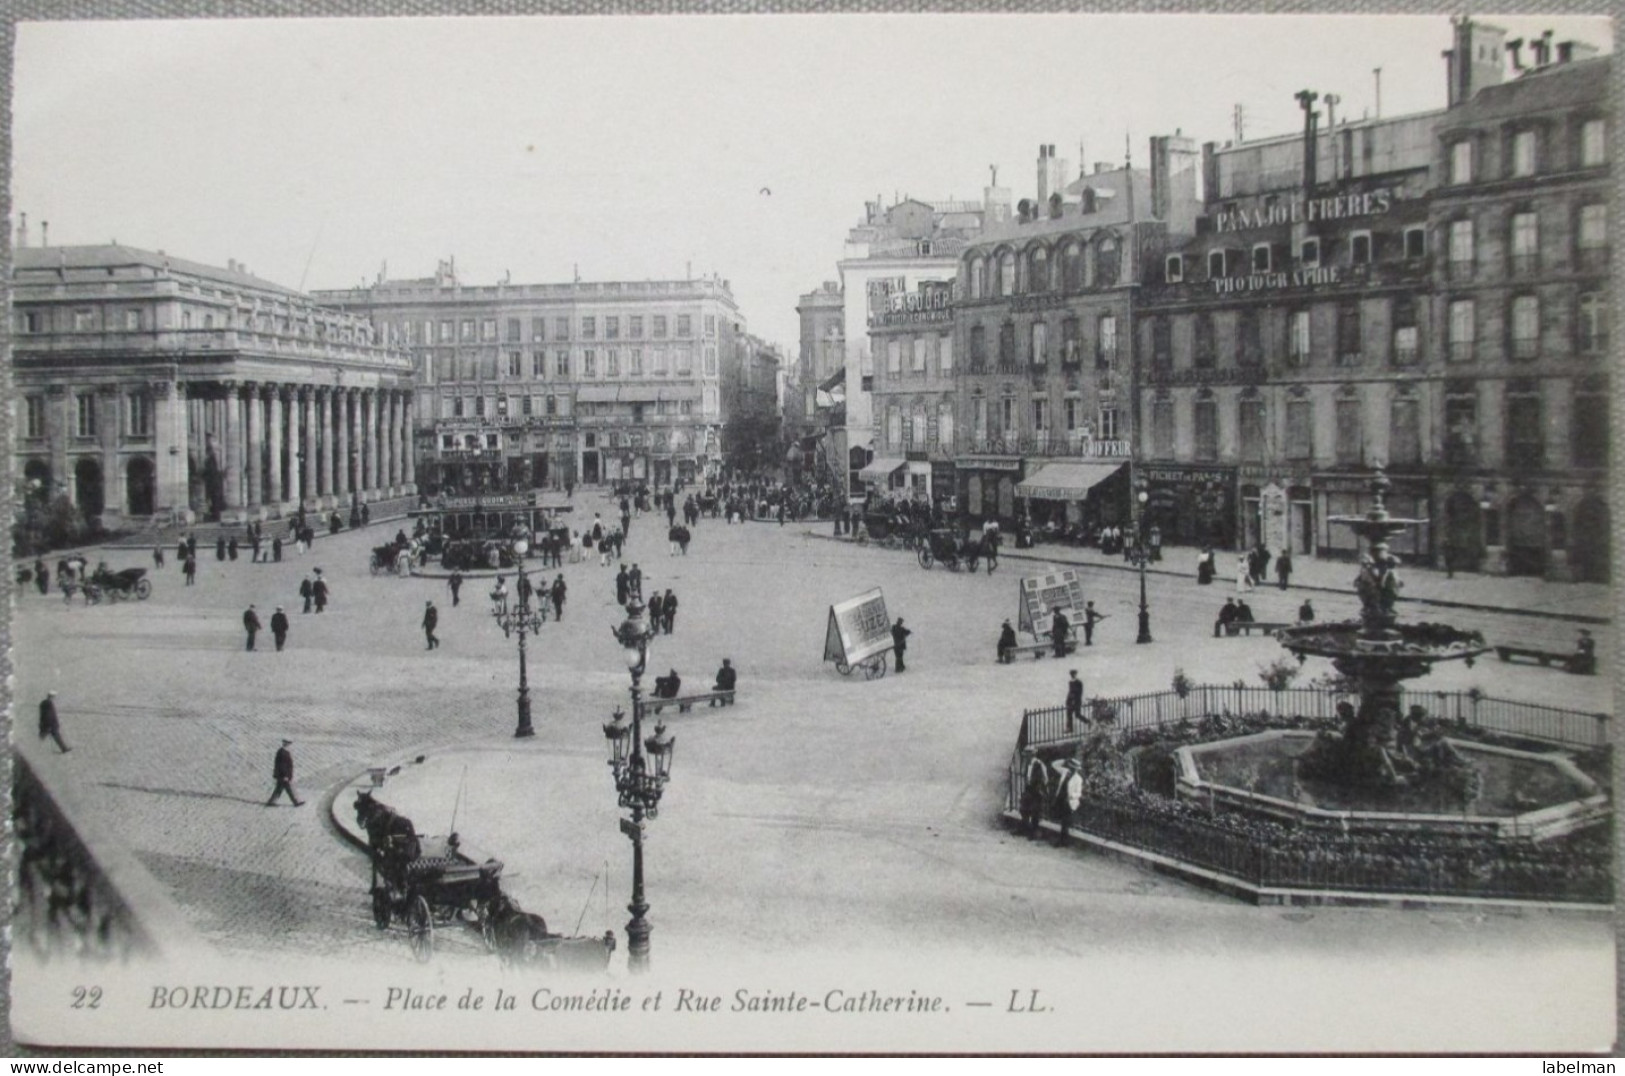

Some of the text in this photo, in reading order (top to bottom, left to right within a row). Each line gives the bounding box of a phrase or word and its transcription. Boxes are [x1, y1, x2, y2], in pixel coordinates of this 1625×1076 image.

[1214, 266, 1340, 294] PHOTOGRAPHIE
[1082, 440, 1131, 455] COIFFEUR
[71, 987, 103, 1009] 22
[384, 987, 448, 1011] Place
[458, 987, 484, 1011] de
[494, 988, 516, 1011] la
[532, 988, 632, 1012] Comédie
[642, 991, 662, 1012] et
[675, 988, 722, 1012] Rue
[731, 988, 950, 1013] Sainte-Catherine.
[1007, 989, 1054, 1013] LL.
